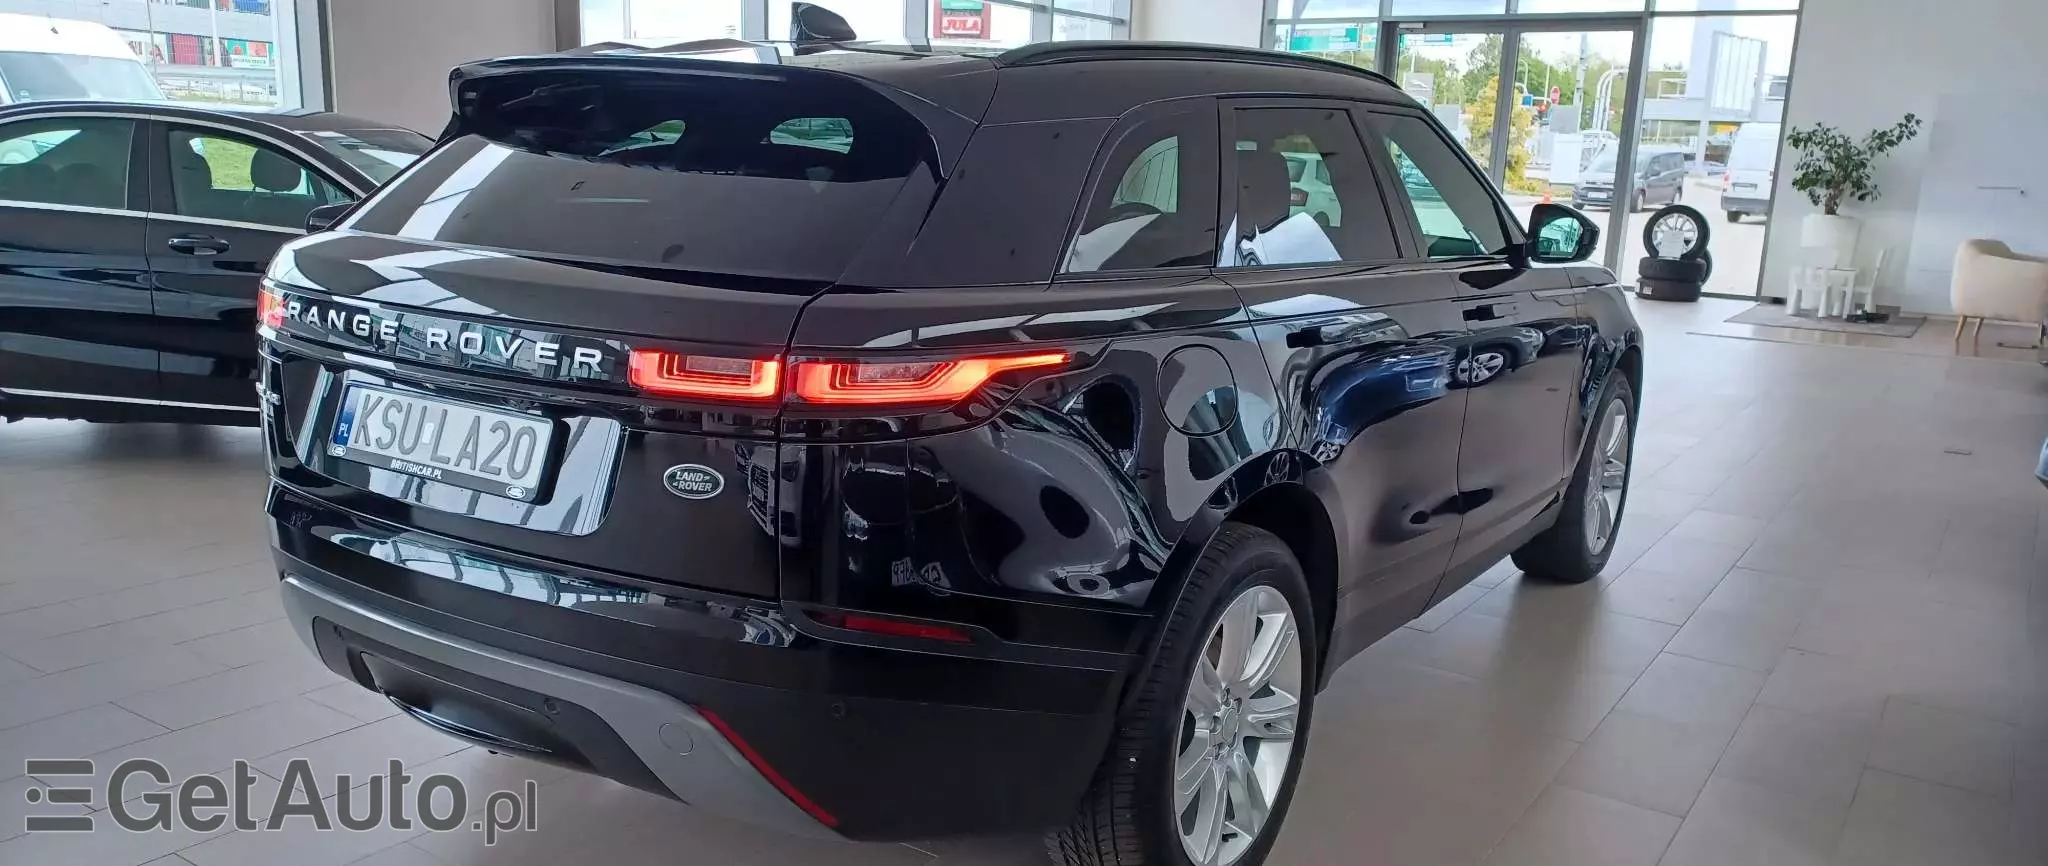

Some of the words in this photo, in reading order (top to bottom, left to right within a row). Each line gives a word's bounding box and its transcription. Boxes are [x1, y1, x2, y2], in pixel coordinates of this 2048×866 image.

[943, 19, 980, 31] JULA
[286, 301, 399, 342] RANGE
[426, 327, 604, 373] ROVER
[338, 423, 349, 438] PL
[390, 459, 443, 480] BRITISHCAR.PL
[675, 471, 704, 481] LAND
[678, 481, 713, 491] ROVER
